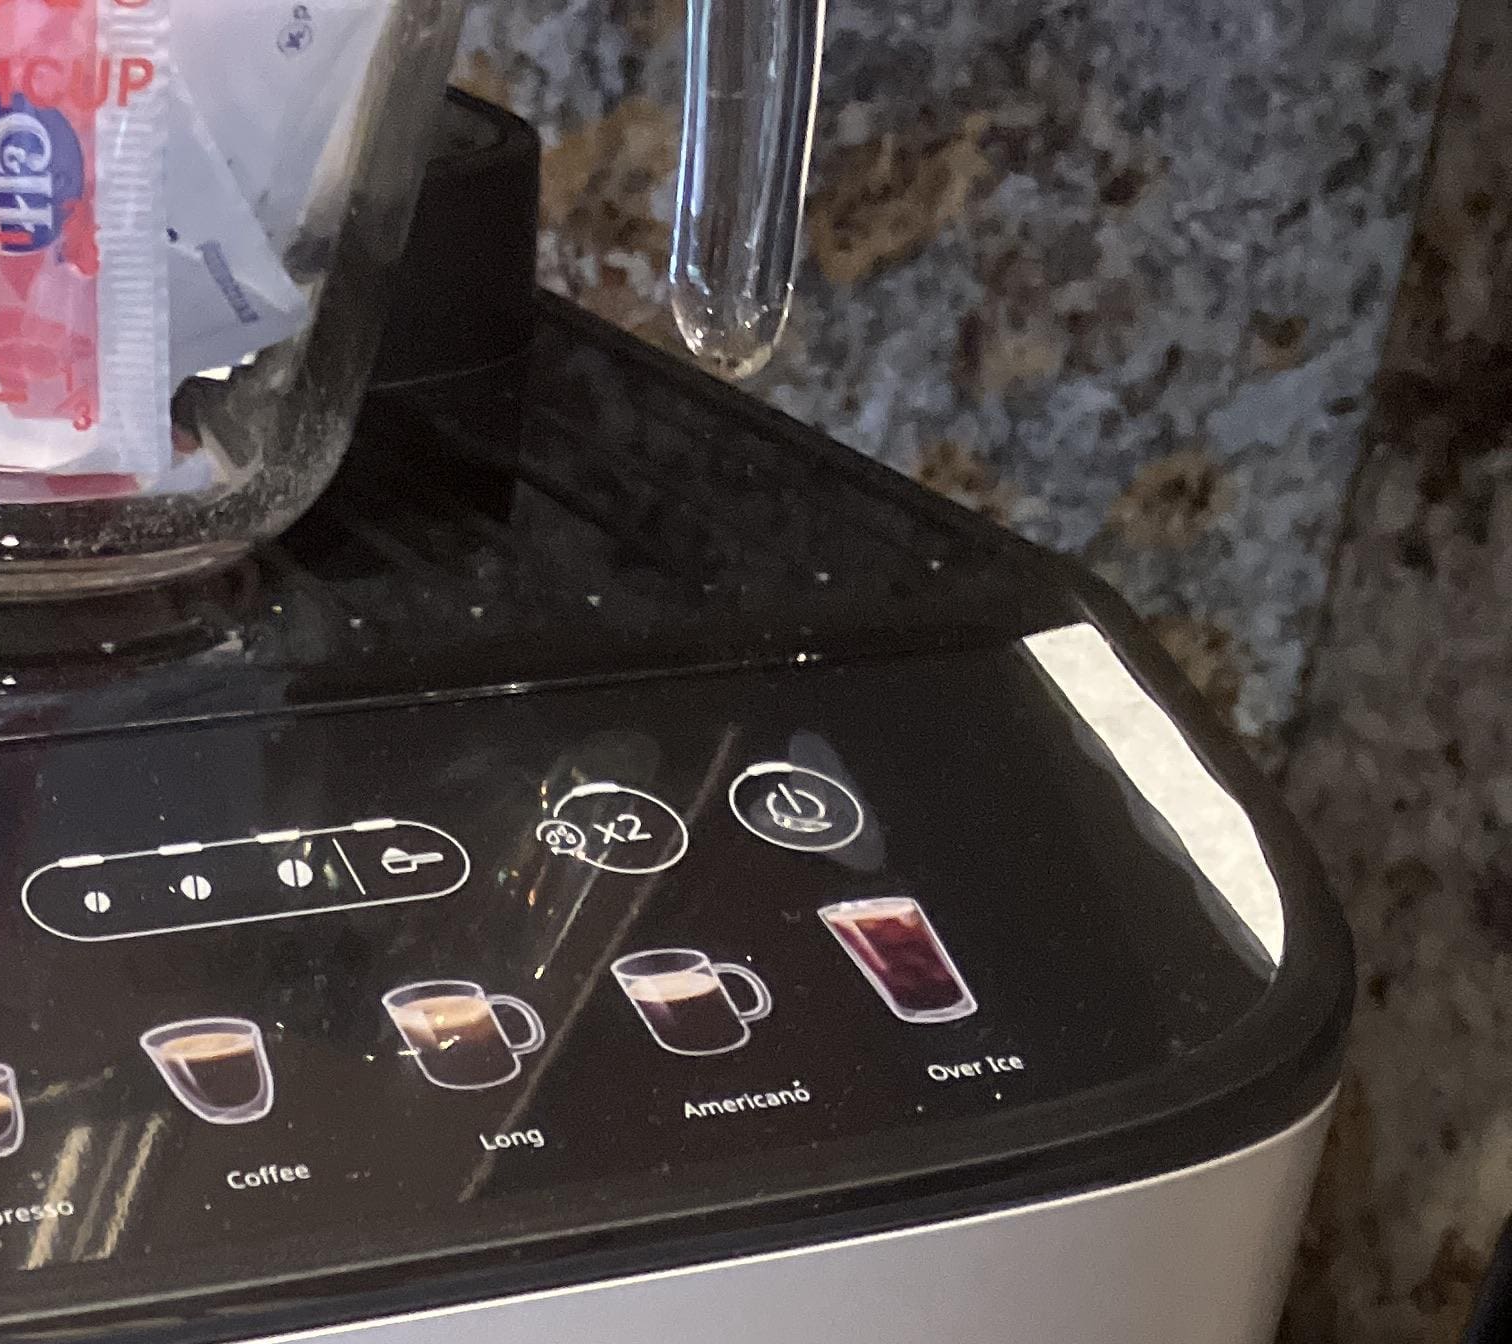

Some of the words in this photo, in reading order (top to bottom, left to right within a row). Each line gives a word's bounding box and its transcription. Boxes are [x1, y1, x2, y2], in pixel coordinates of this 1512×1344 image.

[927, 1060, 982, 1082] Over
[985, 1053, 1025, 1072] Ice
[683, 1084, 811, 1119] Americano
[478, 1124, 545, 1152] Long
[226, 1160, 310, 1190] Coffee
